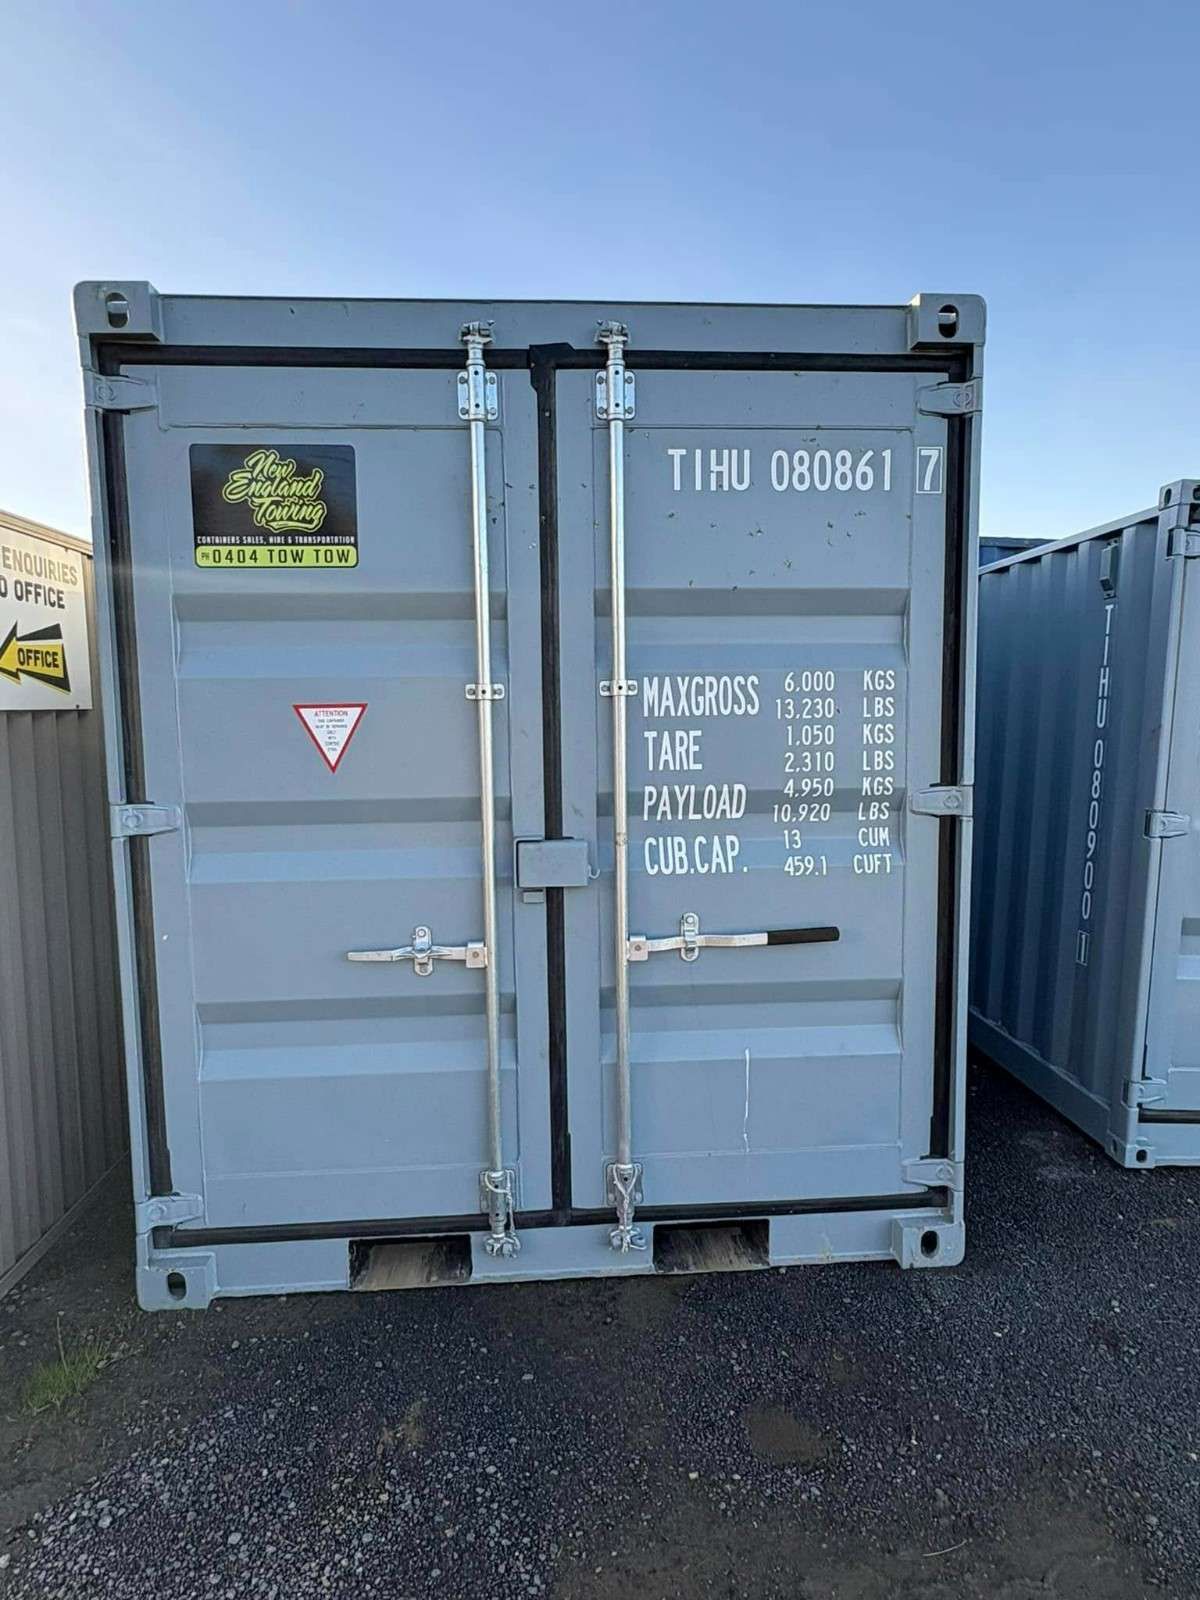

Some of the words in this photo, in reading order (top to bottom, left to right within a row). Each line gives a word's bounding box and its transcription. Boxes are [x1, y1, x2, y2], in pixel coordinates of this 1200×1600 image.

[247, 452, 293, 478] New
[667, 448, 751, 492] TIHU
[770, 449, 893, 492] 080861
[919, 449, 940, 491] 7
[225, 468, 321, 500] England
[252, 496, 324, 522] Towing
[2, 546, 78, 586] ENQUIRIES
[212, 549, 258, 563] 0404
[267, 549, 304, 563] TOW
[313, 549, 350, 563] TOW
[14, 579, 66, 610] OFFICE
[17, 647, 60, 669] OFFICE
[1097, 605, 1114, 728] TIHU
[643, 676, 760, 718] MAXGROSS
[863, 670, 895, 691] KGS
[863, 697, 895, 718] LBS
[644, 730, 703, 771] TARE
[863, 723, 894, 745] KGS
[863, 750, 894, 771] LBS
[643, 783, 747, 821] PAYLOAD
[862, 776, 894, 797] KGS
[858, 802, 890, 821] LBS
[784, 829, 801, 849] 13
[858, 827, 890, 847] CUM
[1081, 739, 1104, 920] 080900
[784, 855, 827, 876] 459.1
[853, 854, 892, 874] CUFT
